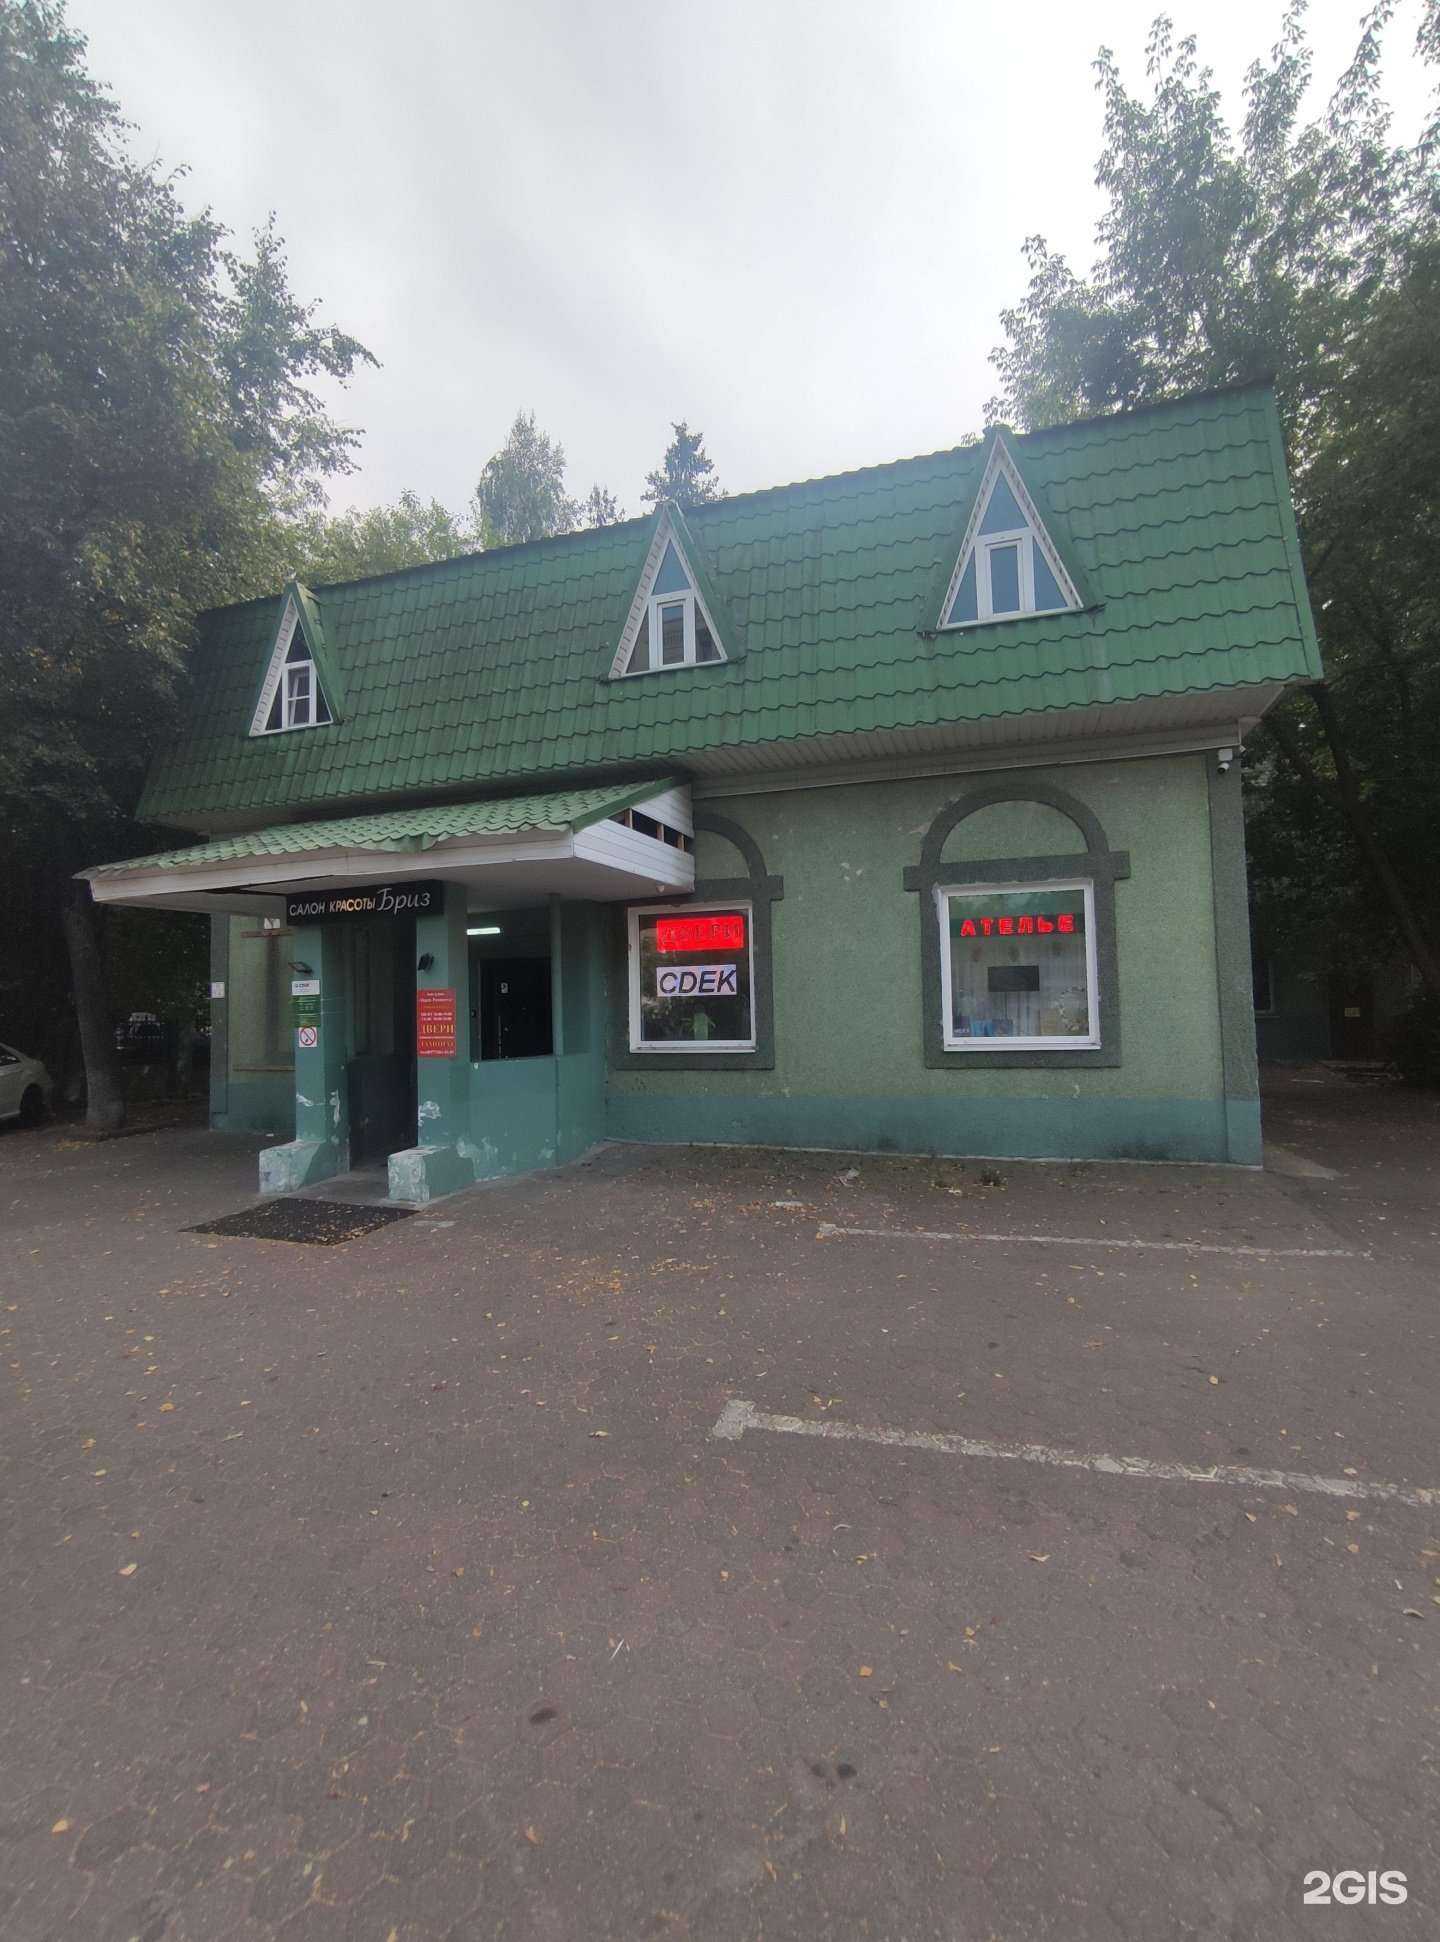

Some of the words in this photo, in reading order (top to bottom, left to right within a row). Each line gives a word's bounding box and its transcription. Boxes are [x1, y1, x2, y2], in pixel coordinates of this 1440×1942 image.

[289, 902, 325, 917] САЛОН
[329, 897, 376, 913] КРАСОТЫ
[376, 888, 431, 915] Бриз
[960, 914, 1075, 937] АТЕЛЬЕ
[659, 969, 737, 994] CDEK
